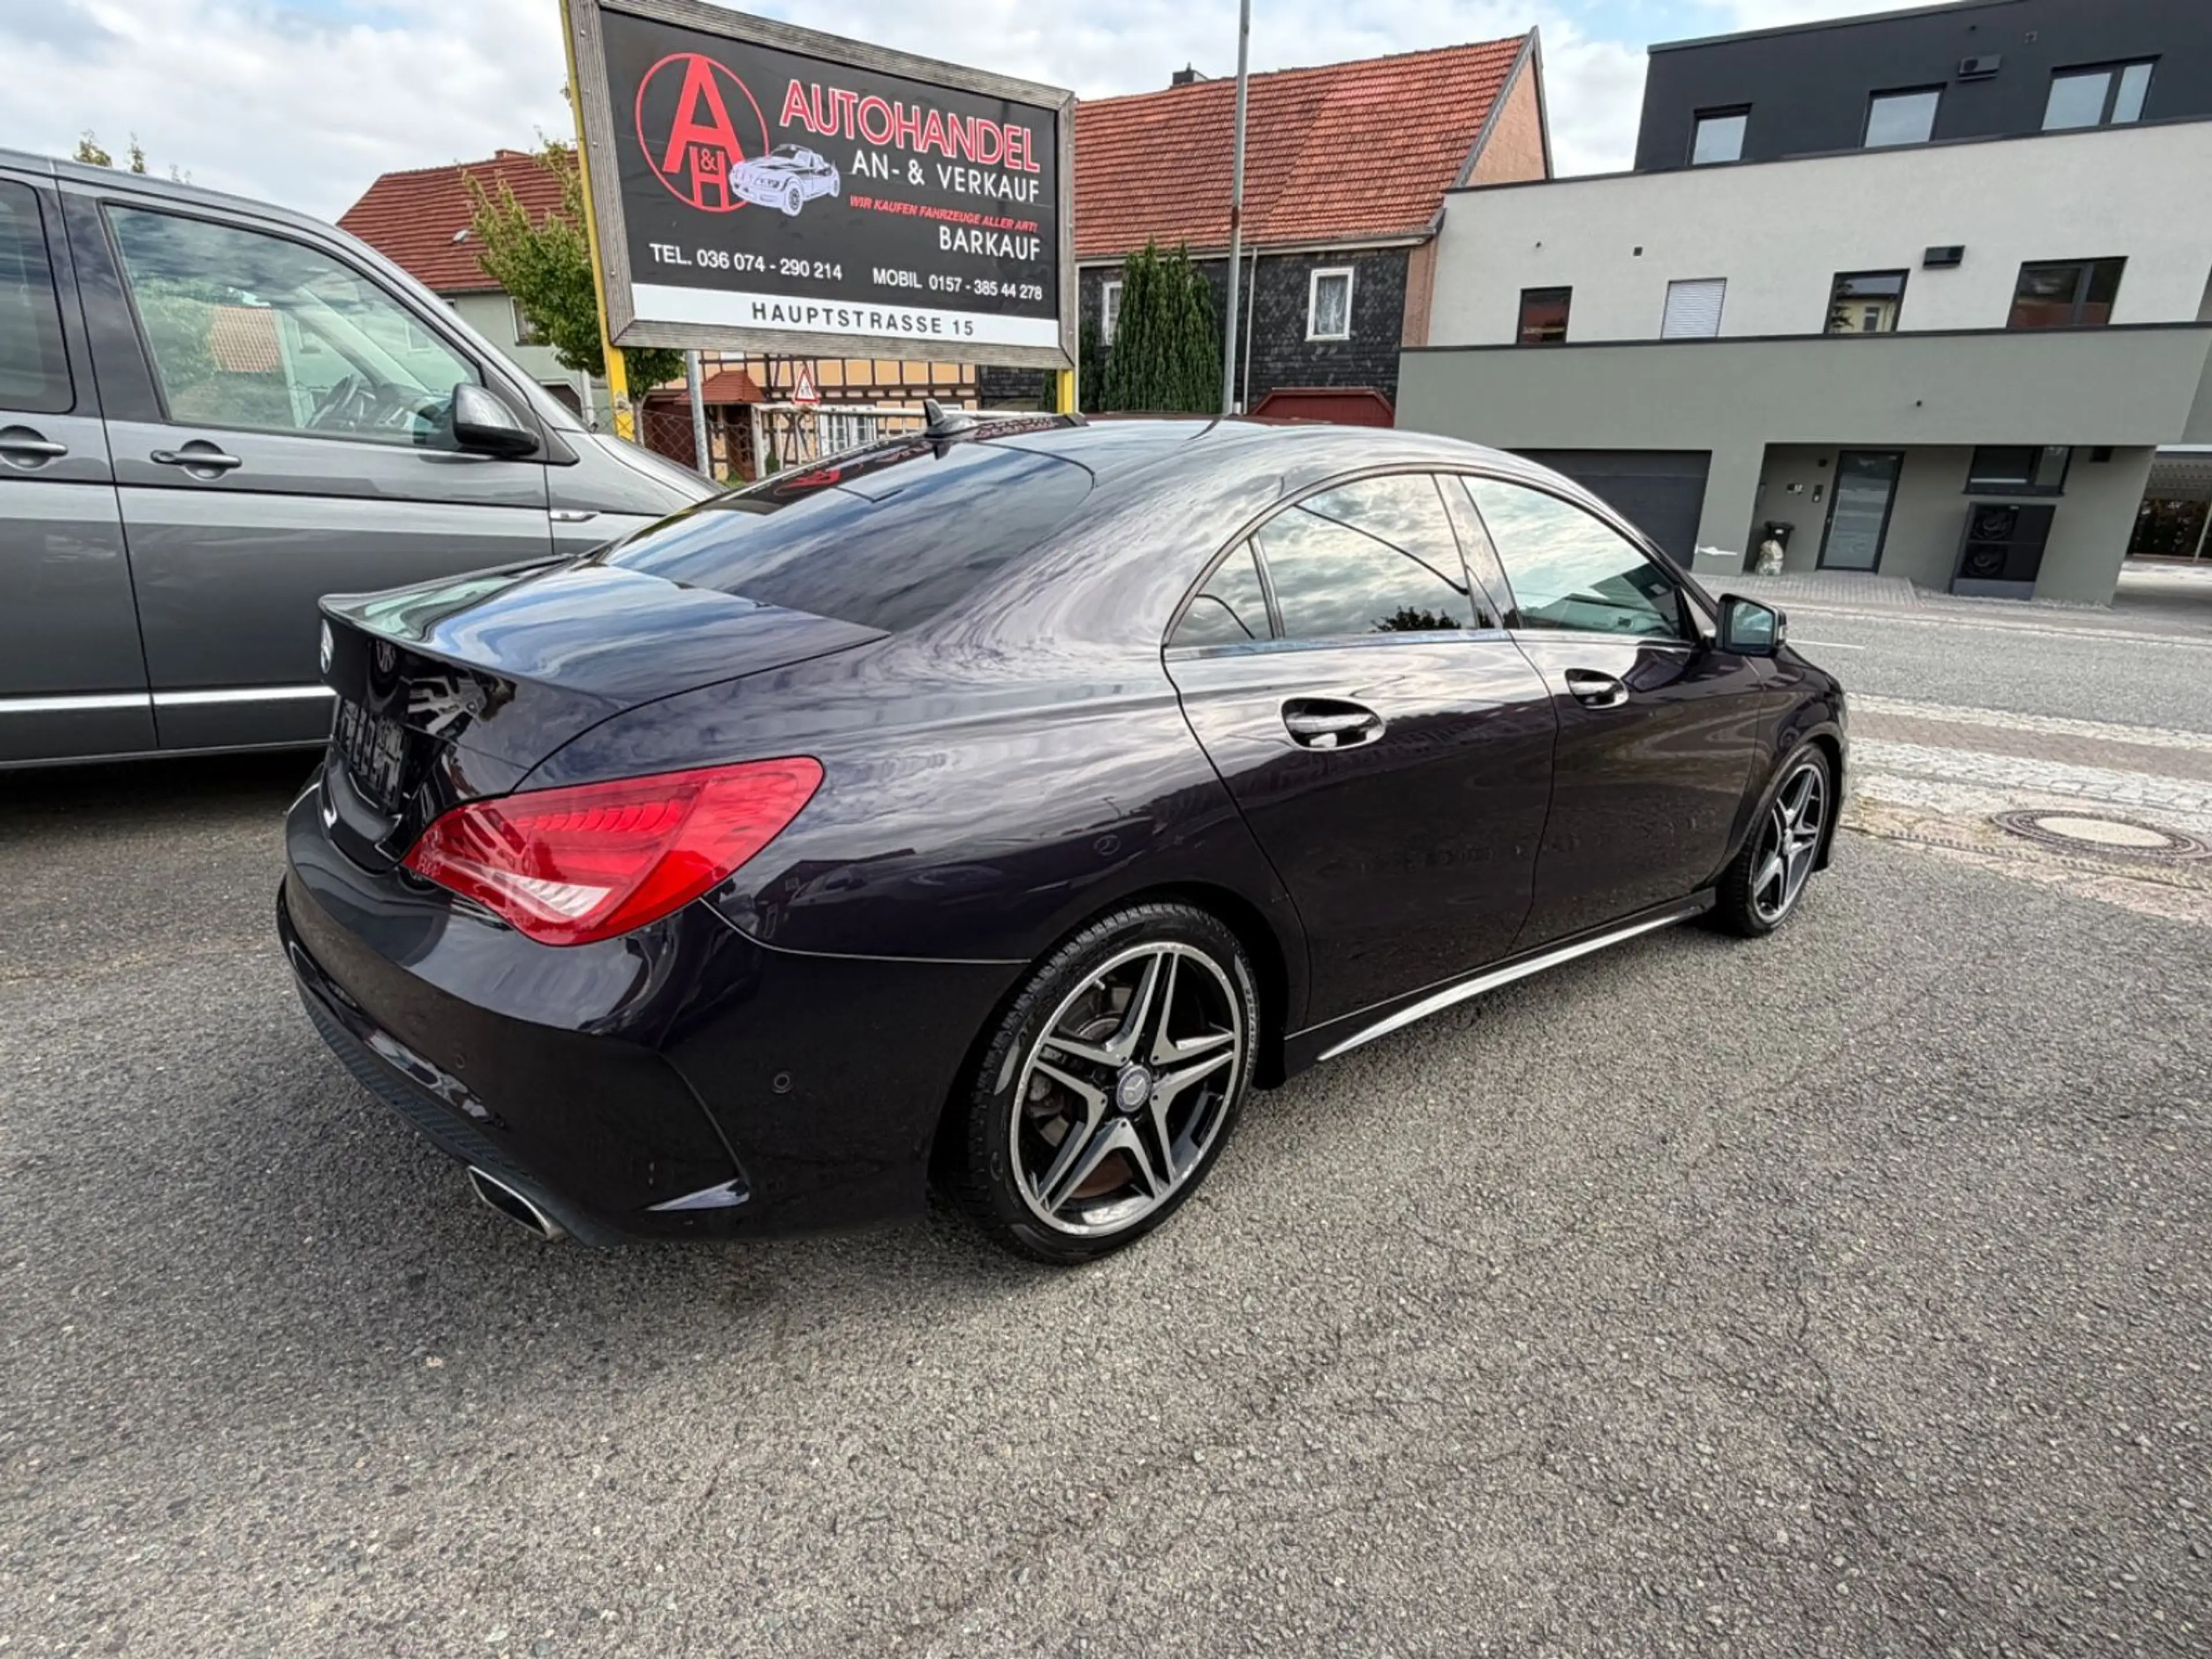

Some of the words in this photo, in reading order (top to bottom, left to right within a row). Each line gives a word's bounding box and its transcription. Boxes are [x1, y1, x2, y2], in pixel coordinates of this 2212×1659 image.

[779, 78, 1040, 173] AUTOHANDEL
[851, 149, 900, 180] AN-
[907, 160, 925, 185] &
[937, 163, 1040, 203] VERKAUF
[850, 194, 872, 209] WIR
[873, 199, 917, 215] KAUFEN
[918, 206, 980, 225] FAHRZEUGE
[982, 215, 1014, 230] ALLER
[1014, 221, 1038, 233] ART!
[939, 225, 1041, 260] BARKAUF
[649, 243, 692, 266] TEL.
[696, 249, 730, 270] 036
[734, 253, 766, 272] 074
[779, 258, 810, 278] 290
[813, 262, 843, 281] 214
[872, 267, 923, 289] MOBIL
[929, 274, 963, 293] 0157
[974, 279, 998, 296] 385
[1001, 283, 1017, 298] 44
[1019, 284, 1042, 300] 278
[752, 302, 942, 334] HAUPTSTRASSE
[952, 320, 974, 336] 15
